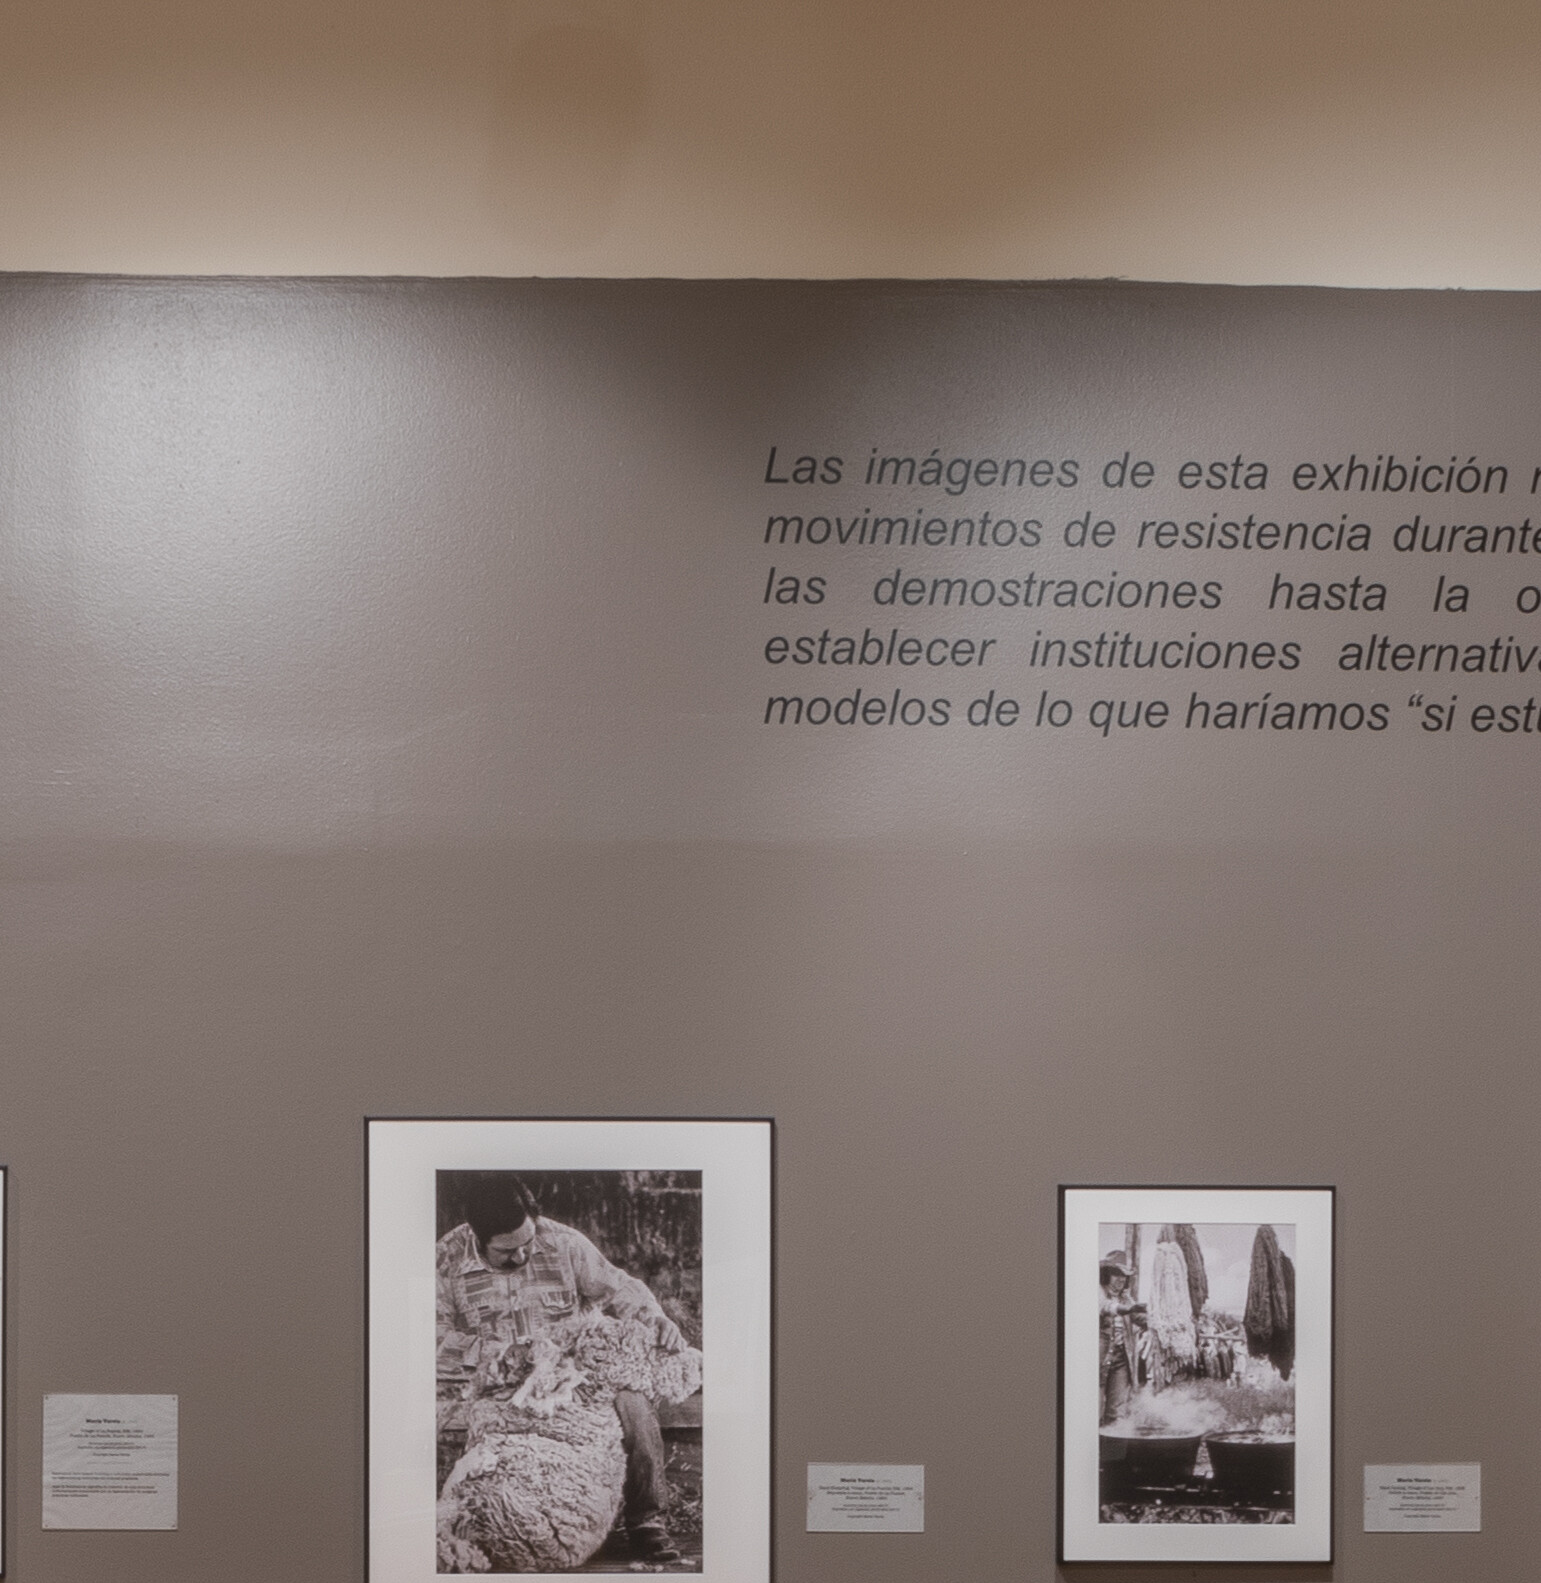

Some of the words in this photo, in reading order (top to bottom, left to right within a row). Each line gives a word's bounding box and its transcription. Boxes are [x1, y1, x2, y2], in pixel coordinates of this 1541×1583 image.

[762, 444, 845, 486] Las
[863, 447, 1081, 498] imágenes
[1101, 450, 1156, 490] de
[1177, 452, 1270, 492] esta
[1291, 452, 1510, 495] exhibición
[762, 509, 1044, 549] movimientos
[1062, 509, 1117, 550] de
[1136, 512, 1373, 553] resistencia
[762, 565, 828, 606] las
[872, 567, 1224, 611] demostraciones
[1267, 571, 1388, 613] hasta
[1432, 573, 1471, 614] la
[763, 626, 998, 668] establecer
[1028, 630, 1303, 672] instituciones
[762, 686, 953, 728] modelos
[966, 688, 1021, 728] de
[1034, 689, 1074, 729] lo
[1088, 699, 1171, 739] que
[1184, 690, 1392, 733] haríamos
[1406, 692, 1457, 734] “si
